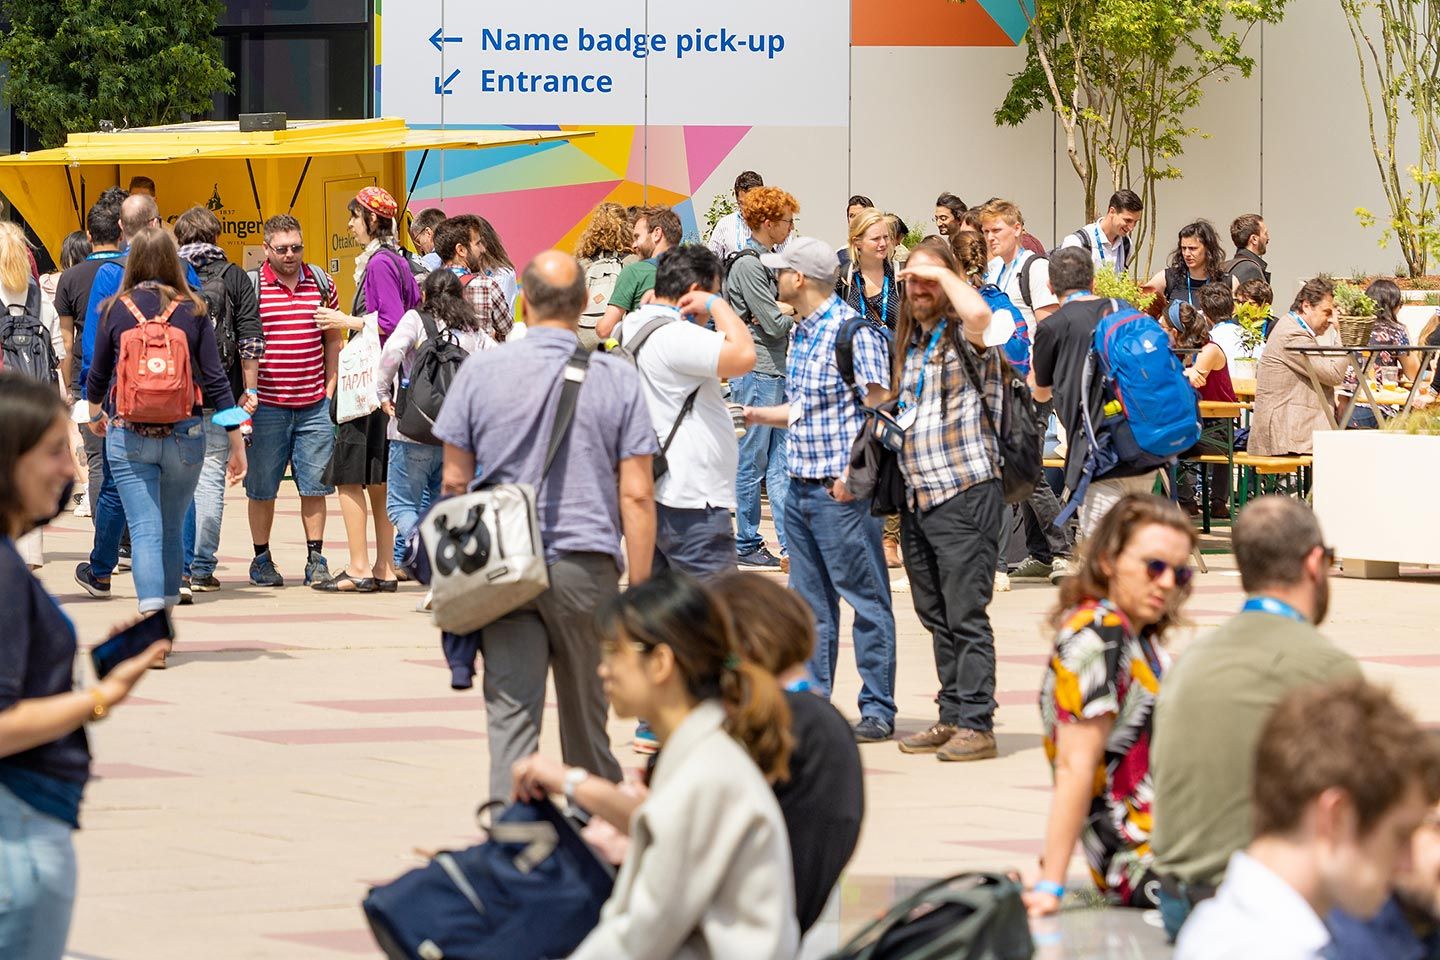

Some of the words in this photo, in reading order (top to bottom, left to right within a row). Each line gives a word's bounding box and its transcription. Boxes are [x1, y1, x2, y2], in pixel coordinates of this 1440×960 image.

[481, 28, 569, 52] Name
[578, 28, 666, 58] badge
[676, 28, 785, 59] pick-up
[481, 70, 613, 94] Entrance
